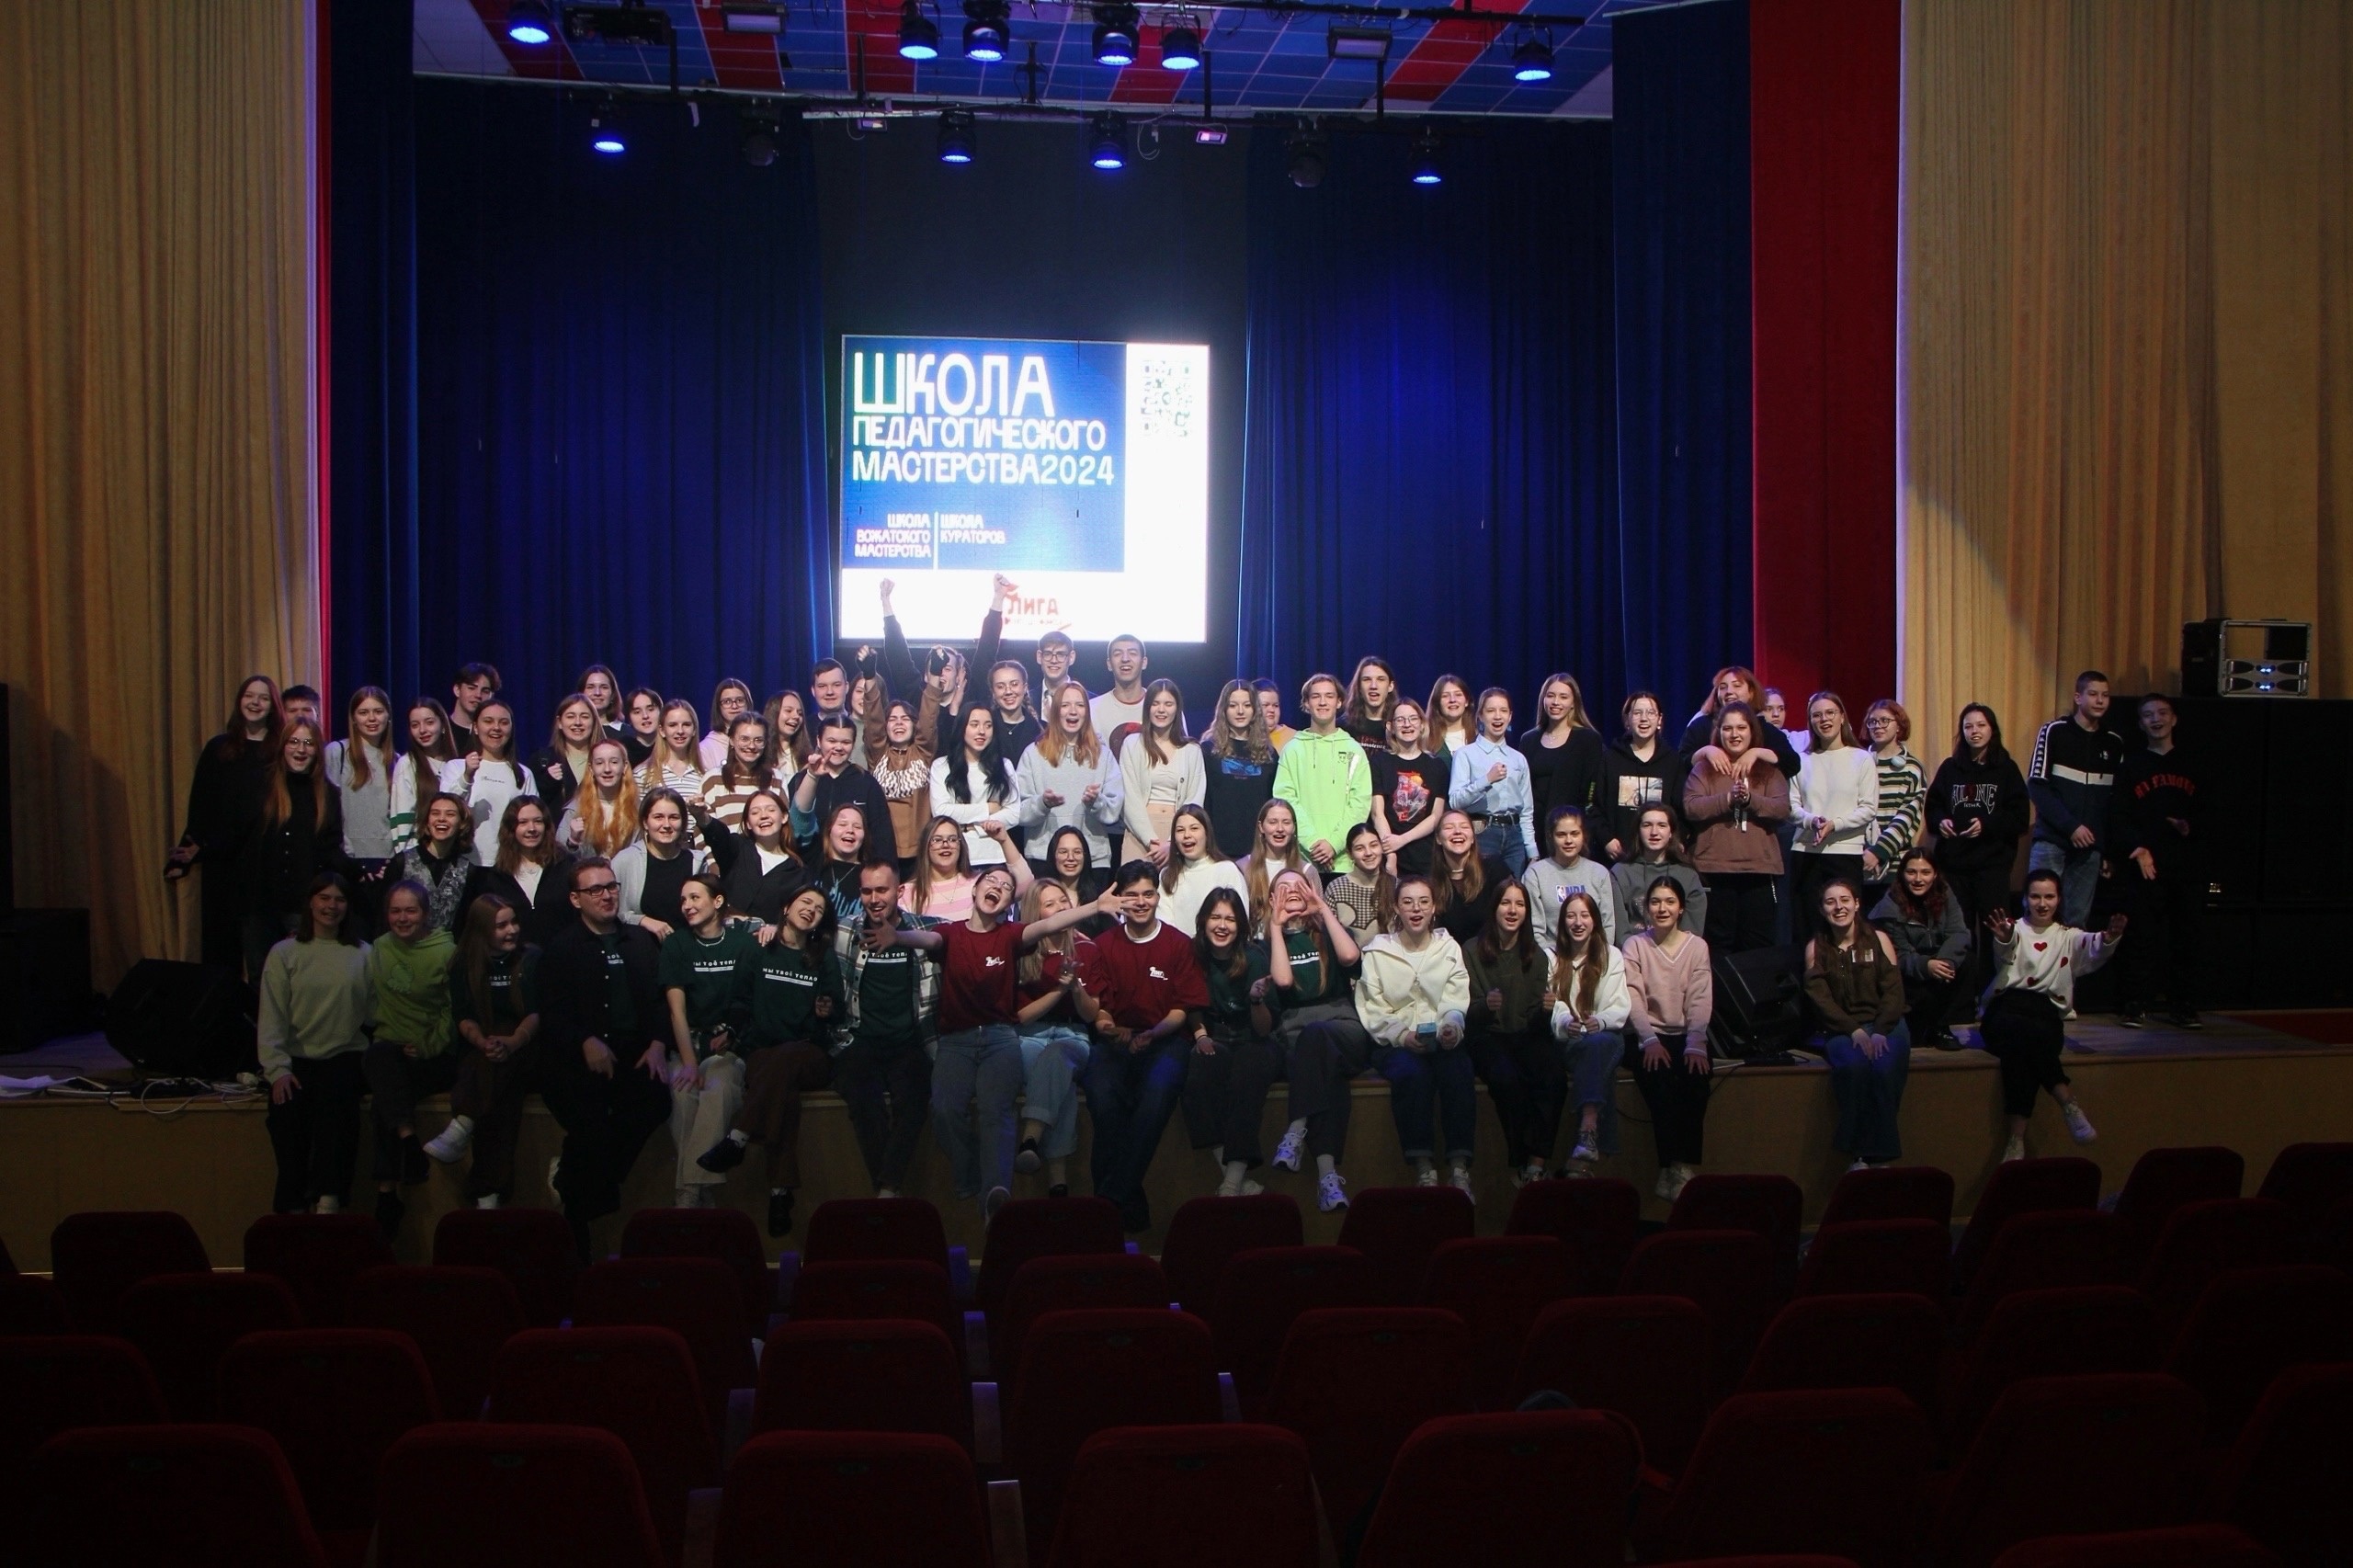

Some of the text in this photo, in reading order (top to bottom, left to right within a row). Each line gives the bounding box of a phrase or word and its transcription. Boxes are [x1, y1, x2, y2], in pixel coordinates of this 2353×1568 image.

[854, 352, 1055, 417] ШКОЛА
[853, 415, 1107, 450] ПЕДАГОГИЧЕСКОГО
[887, 513, 931, 528] ШКОЛА
[939, 514, 983, 529] ШКОЛА
[857, 528, 931, 544] ВОЖАТСКОГО
[939, 529, 1006, 545] КУРАТОРОВ
[854, 543, 931, 558] МАСТЕРСТВА
